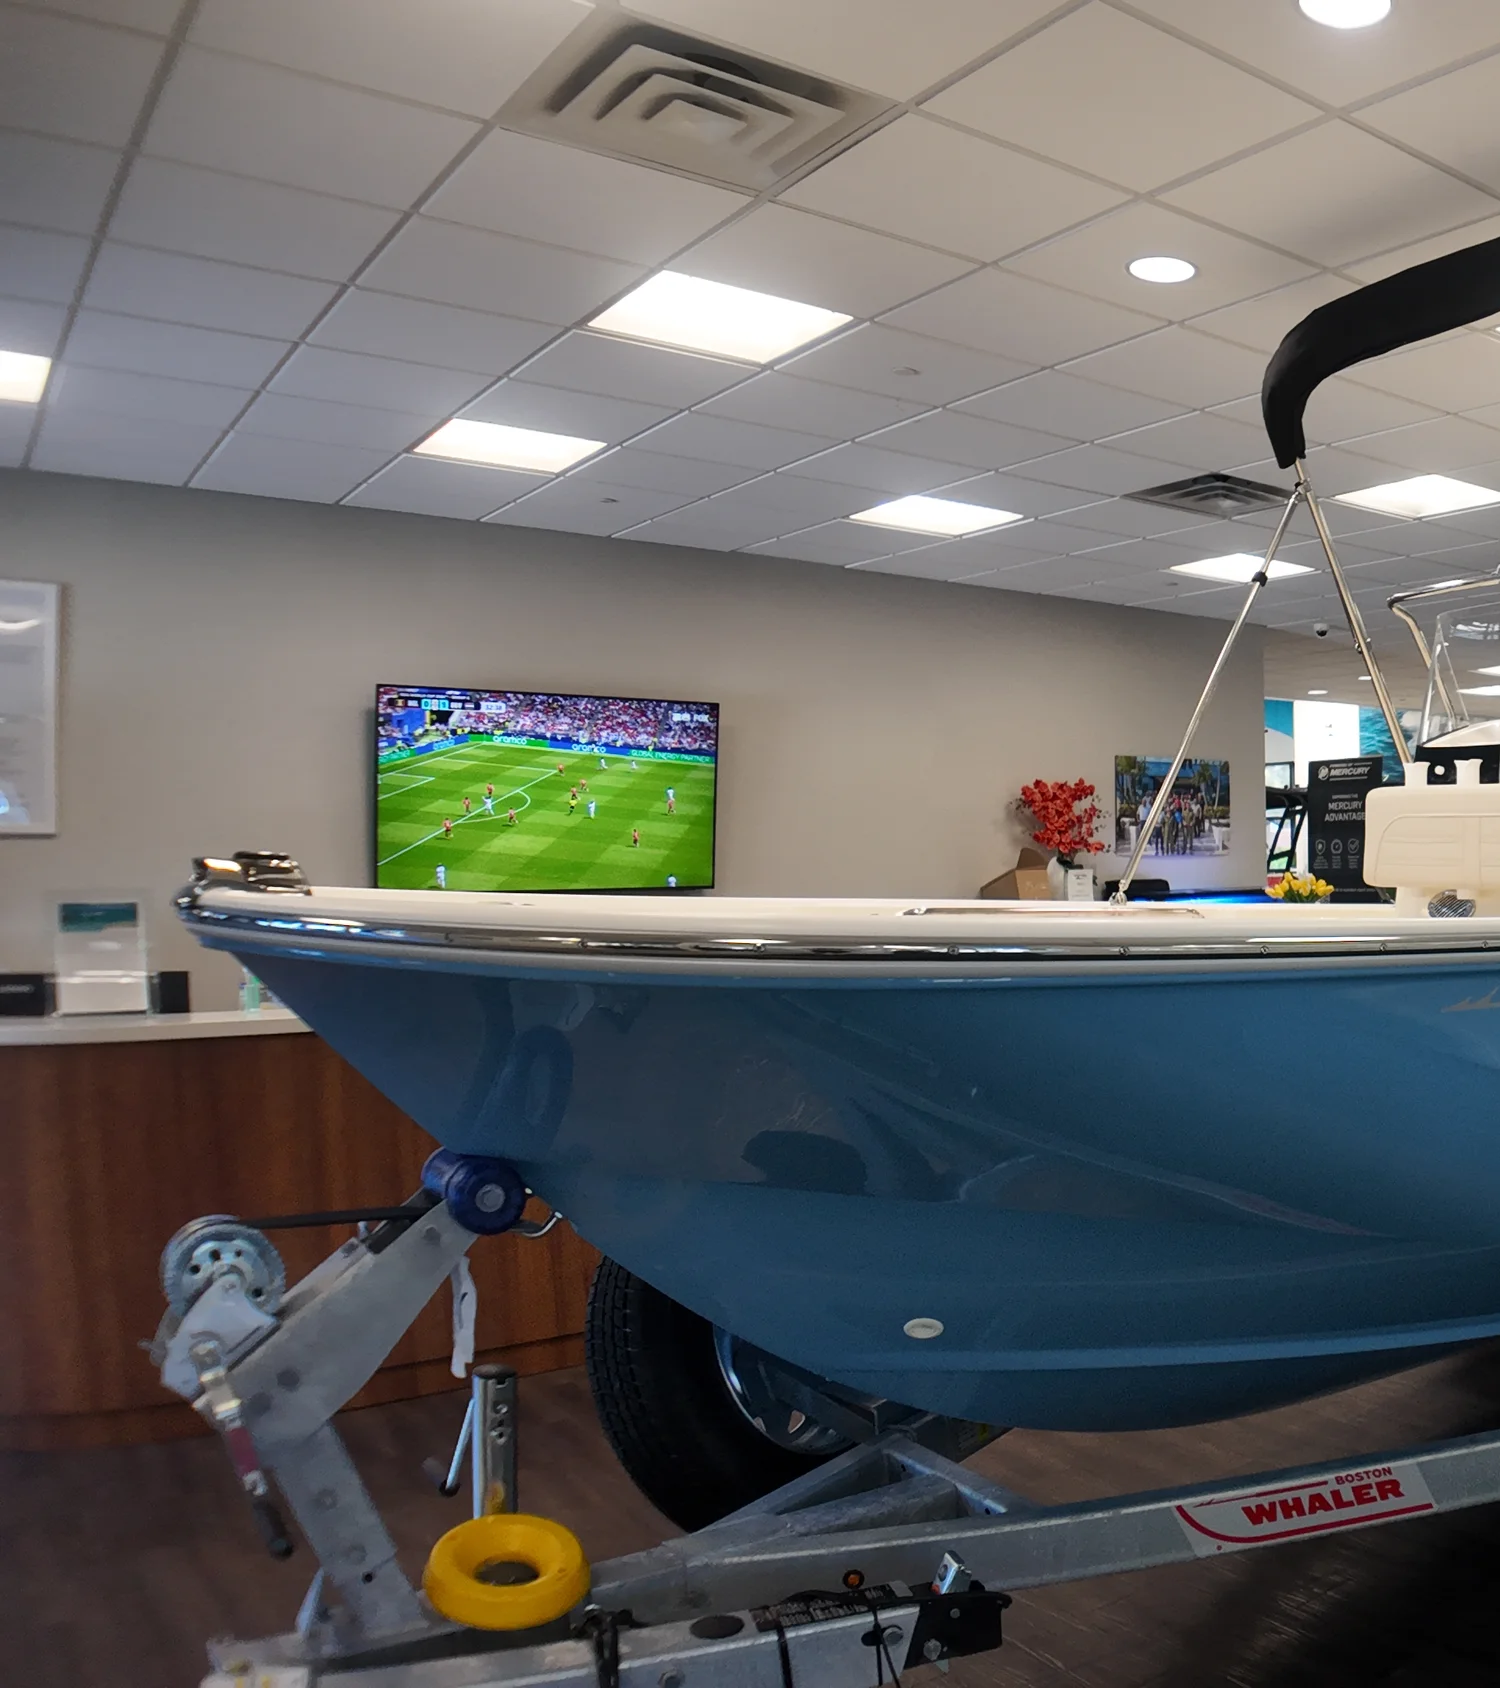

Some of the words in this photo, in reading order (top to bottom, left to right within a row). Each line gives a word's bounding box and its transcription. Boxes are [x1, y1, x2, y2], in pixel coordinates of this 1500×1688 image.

[492, 735, 527, 745] aramco
[571, 743, 606, 753] aramco
[631, 749, 653, 759] GLOBAL
[680, 754, 712, 764] PARTNER
[1329, 767, 1370, 777] MERCURY
[1328, 801, 1362, 811] MERCURY
[1324, 811, 1366, 822] ADVANTAGE
[1334, 1466, 1393, 1485] BOSTON
[1241, 1478, 1405, 1526] WHALER
